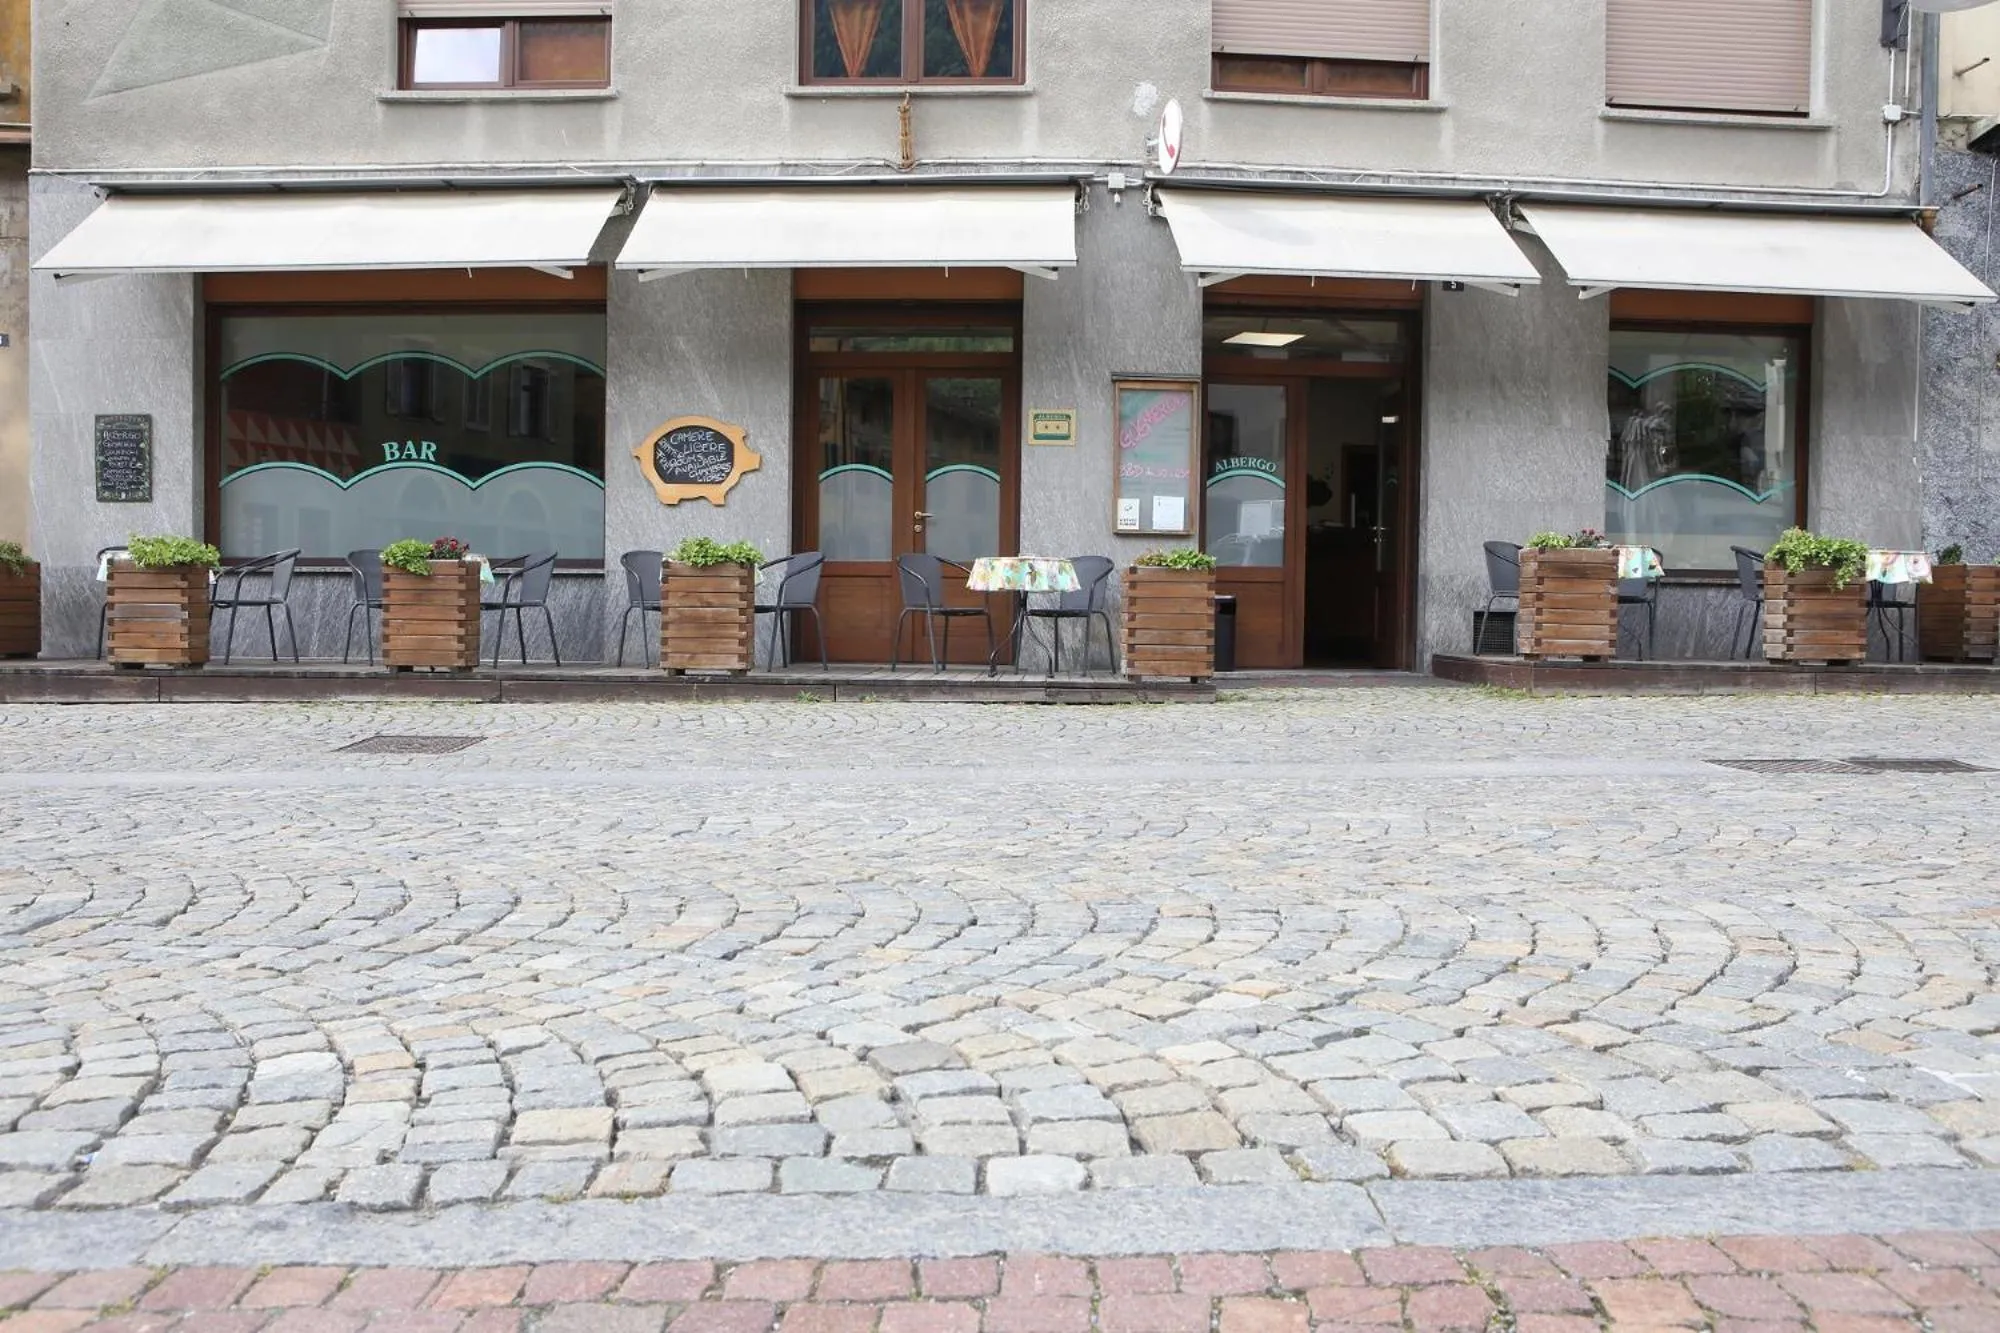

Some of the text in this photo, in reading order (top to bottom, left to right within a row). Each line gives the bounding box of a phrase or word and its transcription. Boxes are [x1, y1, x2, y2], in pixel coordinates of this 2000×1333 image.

[670, 431, 714, 444] CAMERE
[381, 439, 437, 462] BAR
[1215, 456, 1277, 473] ALBERGO
